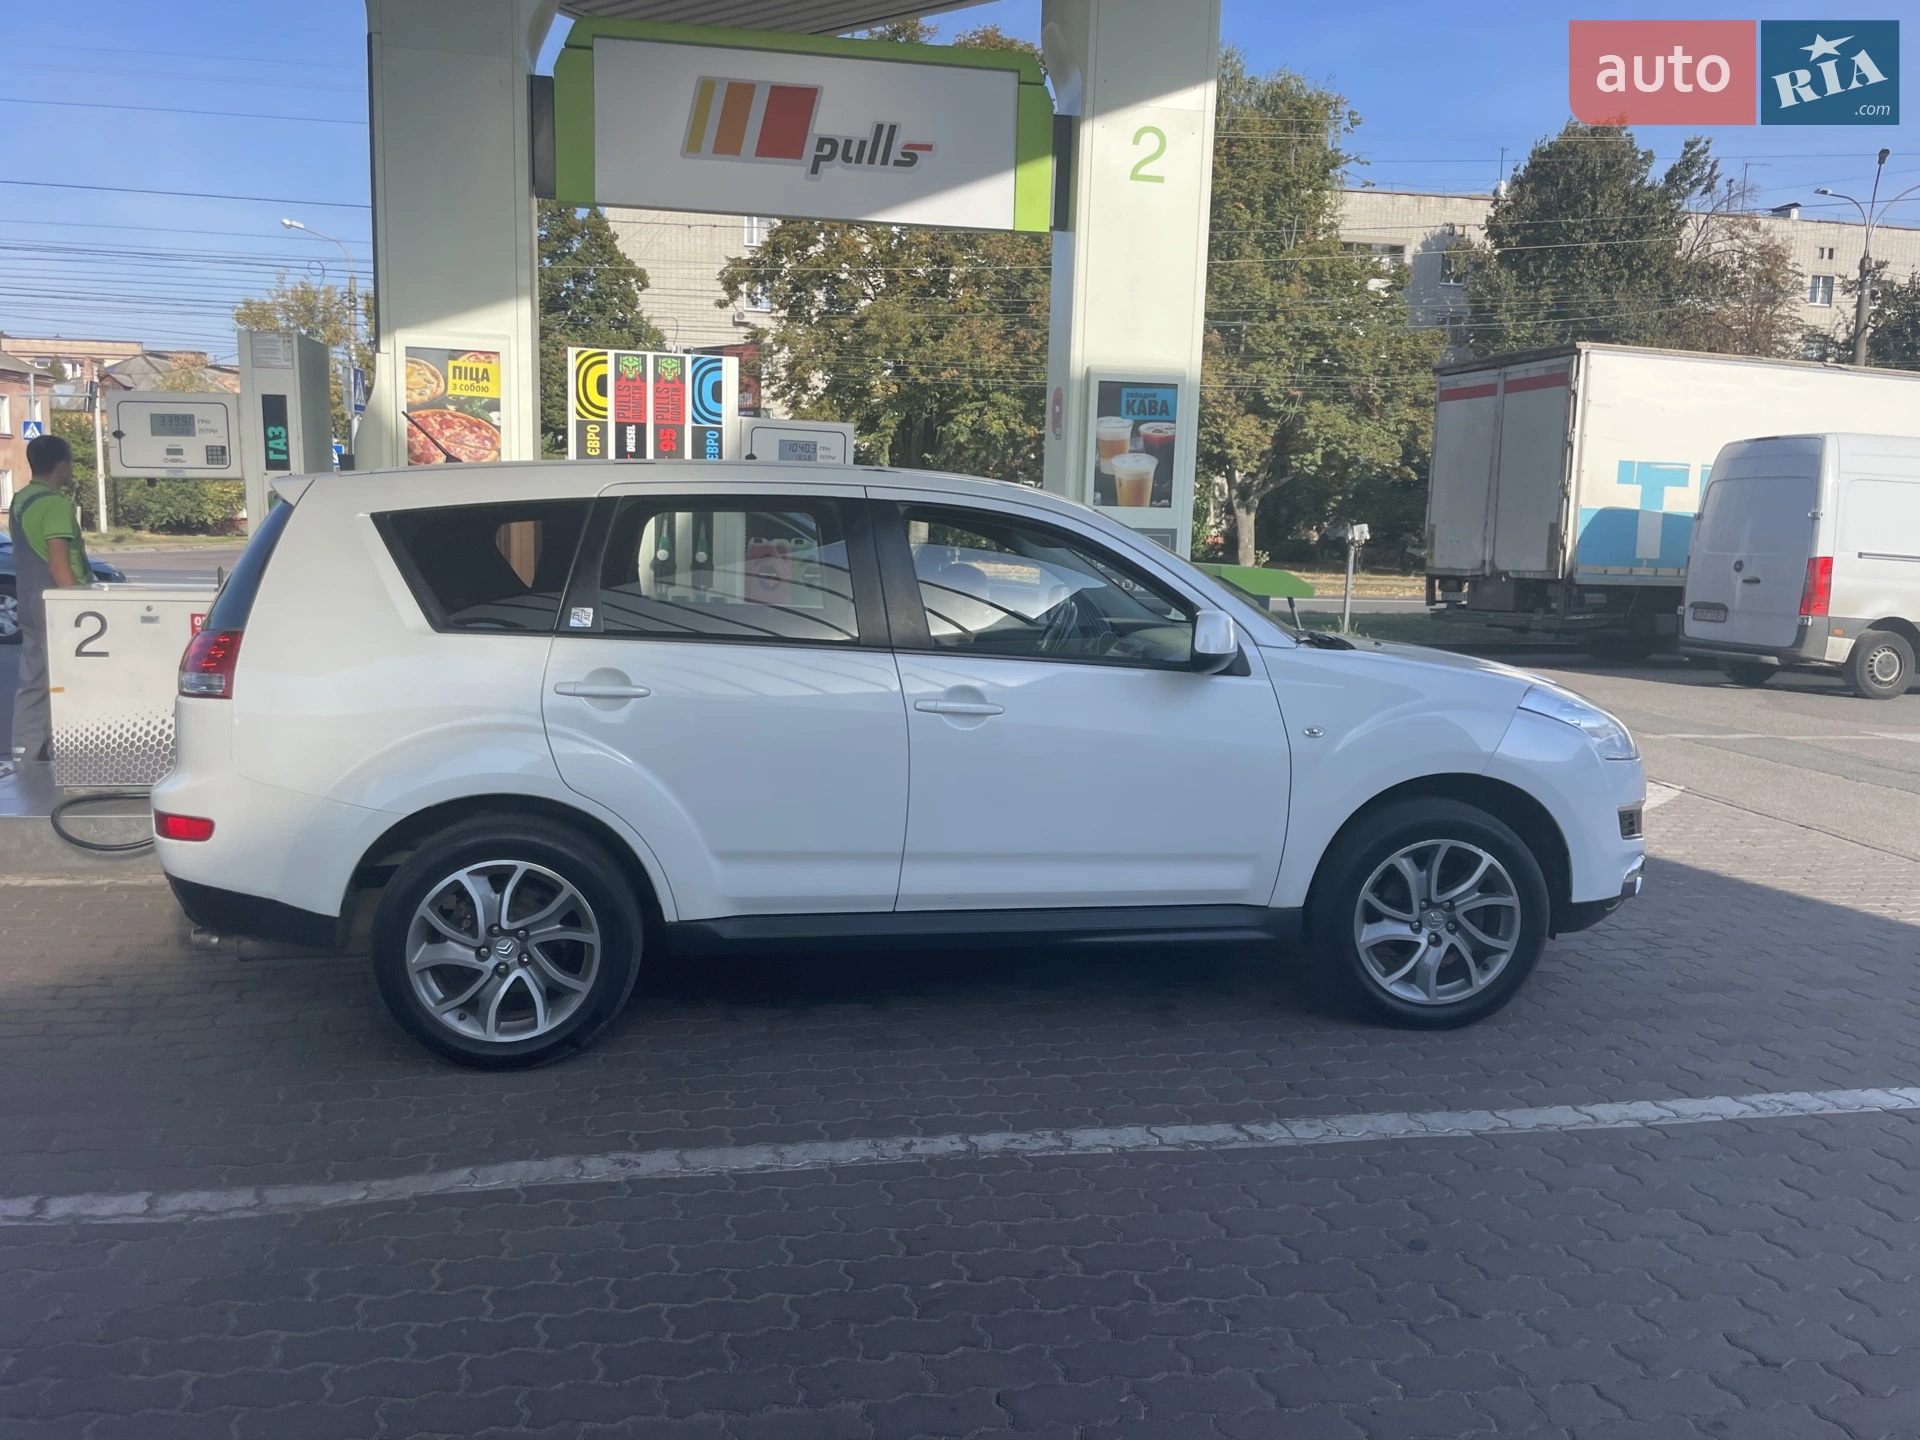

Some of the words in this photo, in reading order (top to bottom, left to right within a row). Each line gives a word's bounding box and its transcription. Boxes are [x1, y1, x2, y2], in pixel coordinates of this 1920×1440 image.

[809, 123, 934, 175] pulls
[1130, 126, 1167, 184] 2
[452, 365, 490, 383] ПІЦА
[460, 382, 489, 393] собою
[616, 384, 631, 420] PULLS
[655, 386, 670, 421] PULLS
[1125, 399, 1170, 416] КАВА
[267, 426, 288, 460] ГАЗ
[586, 424, 601, 456] ЄВРО
[626, 424, 636, 453] DIESEL
[659, 428, 677, 451] 95
[74, 611, 109, 657] 2
